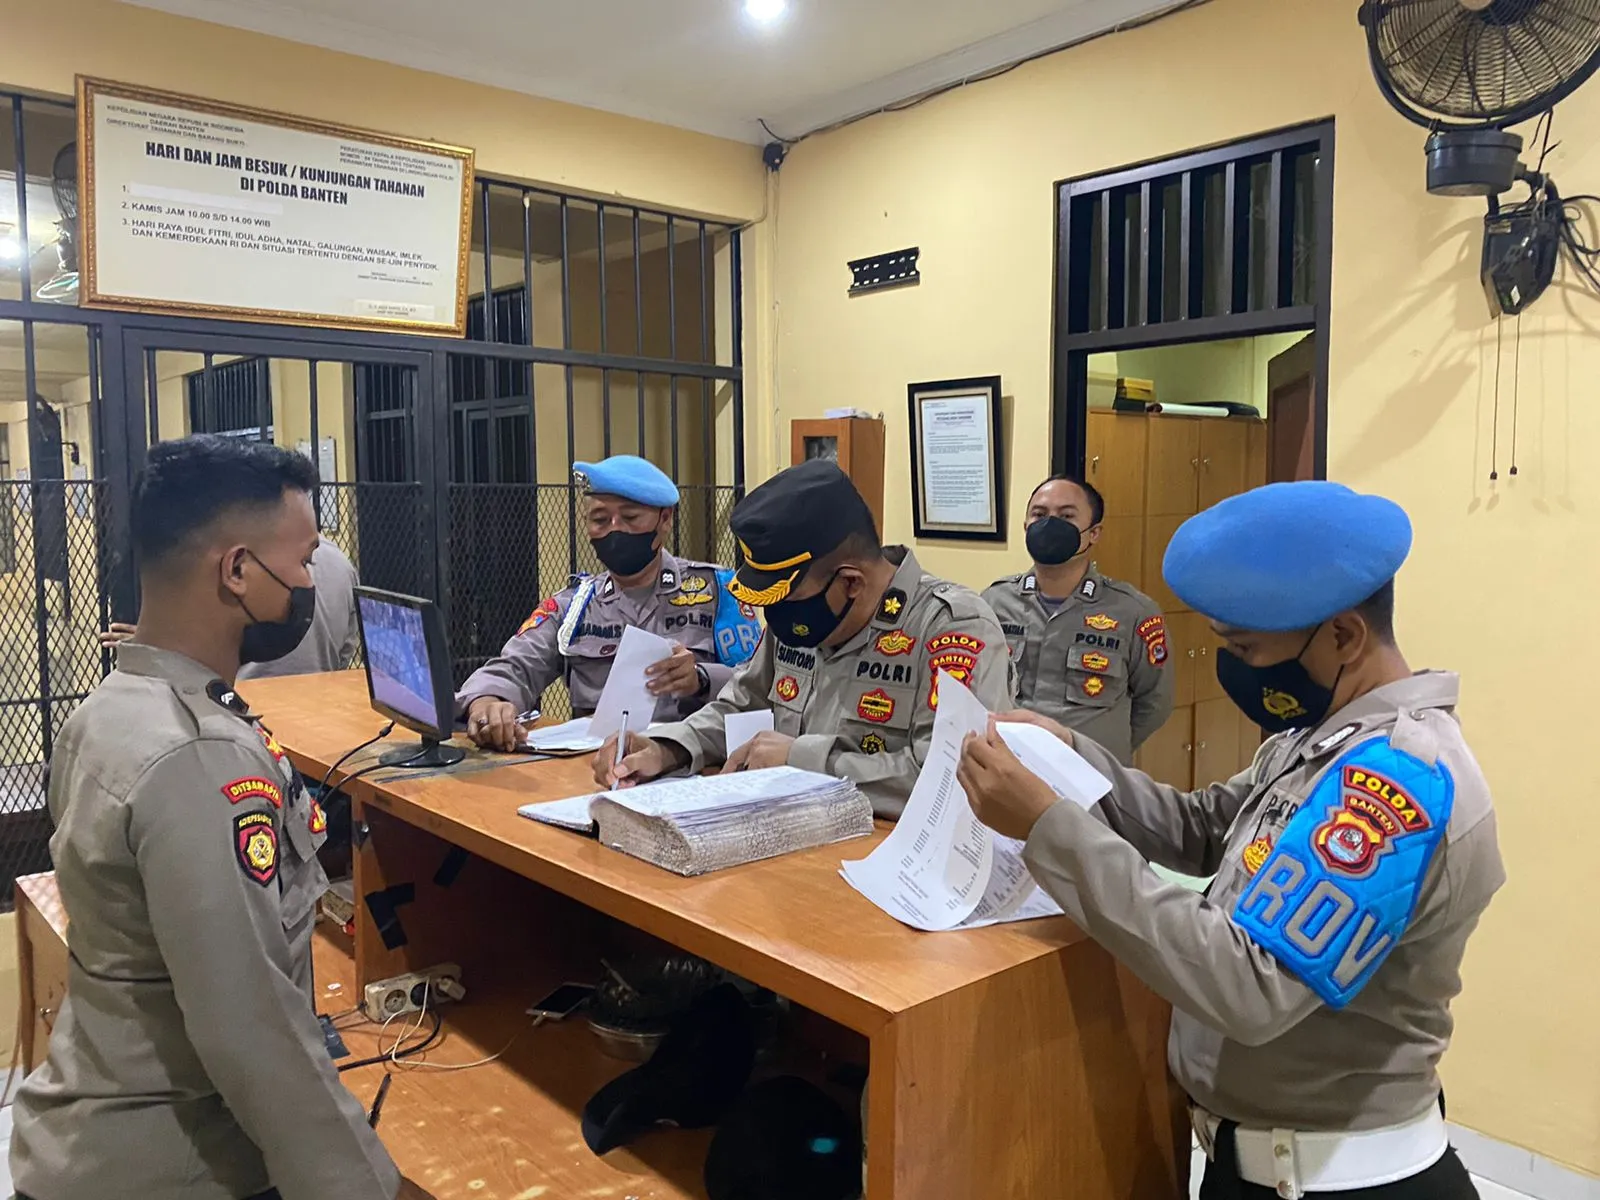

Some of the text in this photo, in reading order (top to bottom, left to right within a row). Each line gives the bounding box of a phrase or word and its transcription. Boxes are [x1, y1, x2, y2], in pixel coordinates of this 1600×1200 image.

[146, 141, 425, 198] HARI DAN JAM BESUK / KUNJUNGAN TAHANAN
[240, 176, 348, 205] DI POLDA BANTEN
[122, 201, 271, 228] 2. KAMIS JAM 10.00 S/D 14.00 WIB
[132, 219, 156, 230] HARI
[158, 222, 183, 233] RAYA
[185, 226, 206, 236] IDUL
[208, 229, 234, 240] FITRI,
[235, 232, 256, 242] IDUL
[286, 238, 315, 250] NATAL,
[317, 242, 365, 255] GALUNGAN,
[400, 252, 422, 261] IMLEK
[132, 228, 153, 238] DAN
[155, 230, 228, 247] KEMERDEKAAN
[230, 239, 239, 248] RI
[241, 241, 260, 251] DAN
[262, 243, 295, 255] SITUASI
[297, 248, 340, 260] TERTENTU
[342, 253, 374, 264] DENGAN
[665, 613, 713, 631] POLRI
[931, 635, 978, 650] POLDA
[1075, 632, 1121, 650] POLRI
[856, 660, 912, 684] POLRI
[933, 655, 972, 667] BANTEN
[1351, 771, 1417, 825] POLDA
[1349, 796, 1395, 831] BANTEN
